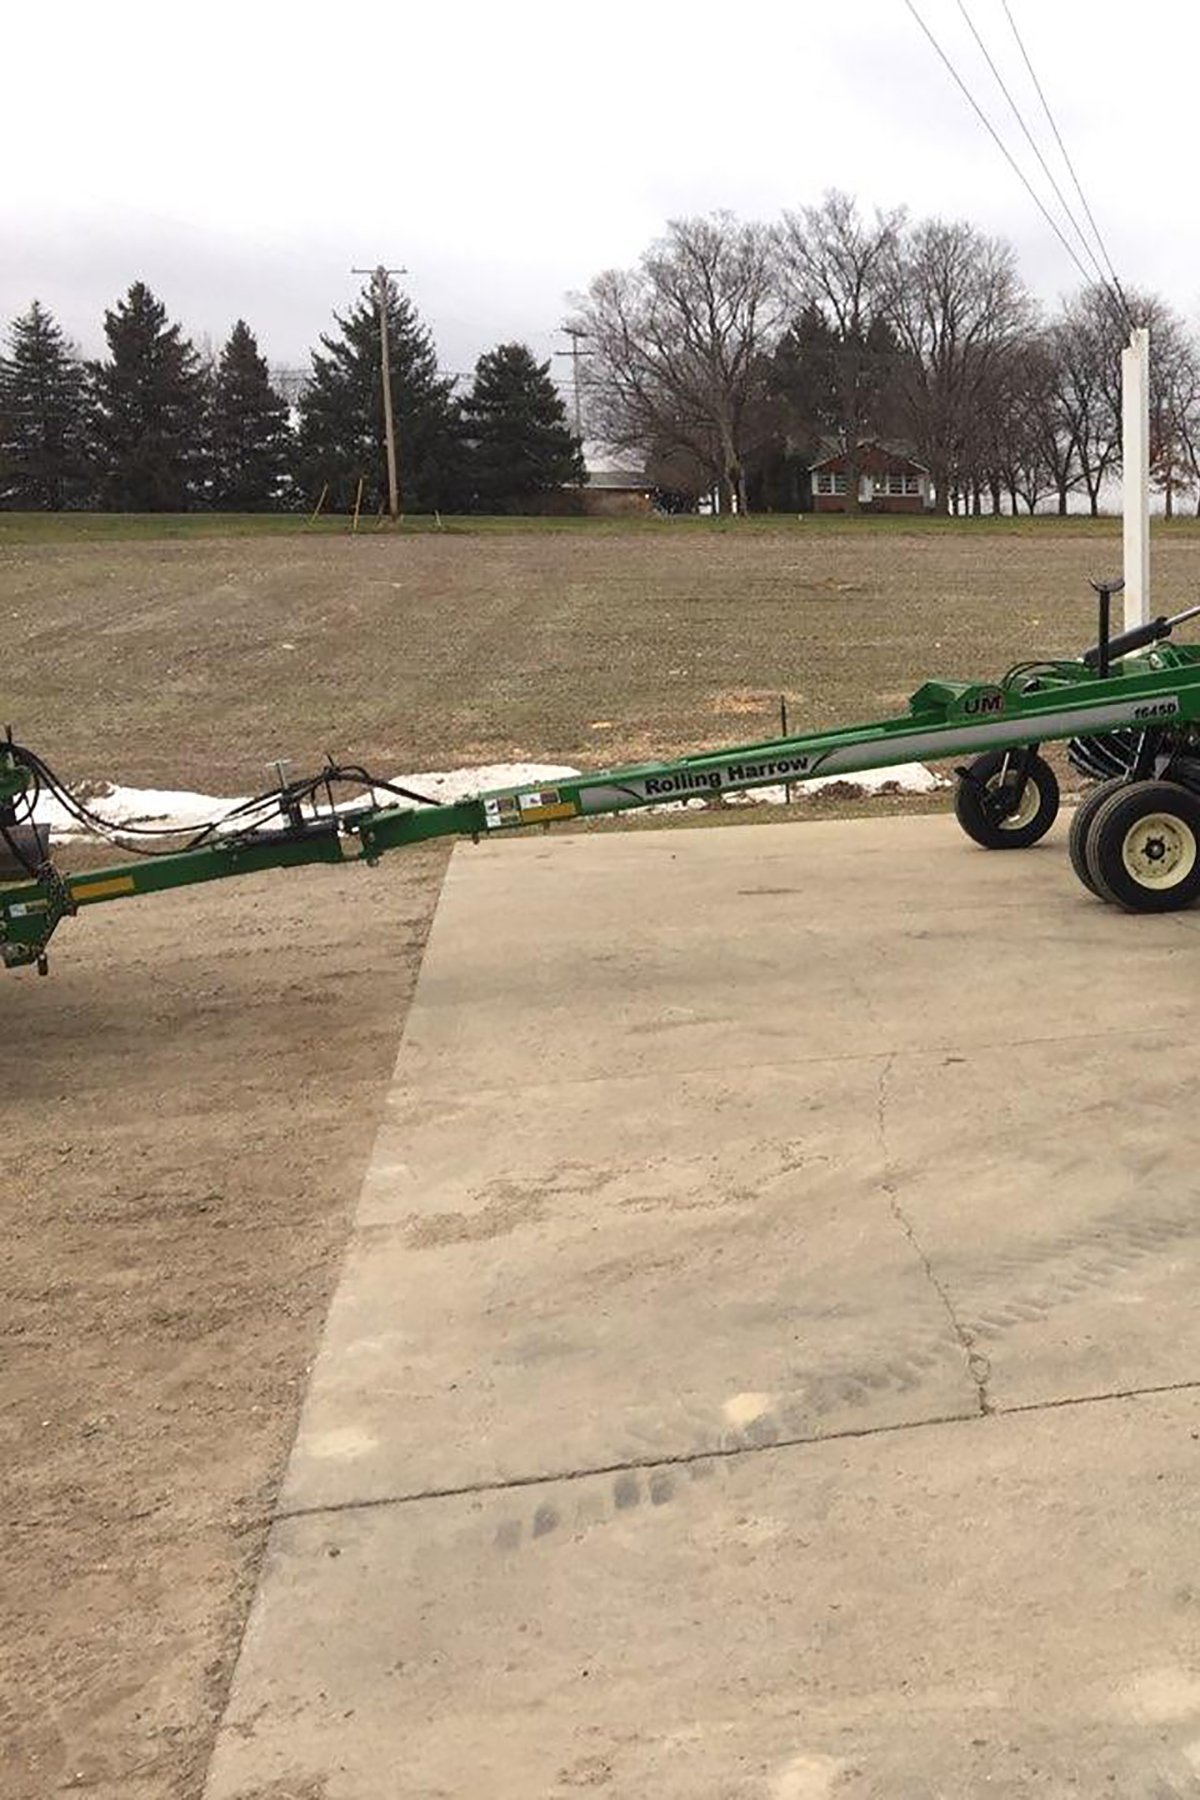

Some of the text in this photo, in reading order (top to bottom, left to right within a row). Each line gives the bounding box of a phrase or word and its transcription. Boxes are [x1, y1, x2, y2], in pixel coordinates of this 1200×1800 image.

[964, 694, 1001, 714] UM
[644, 757, 809, 795] Rolling Harrow
